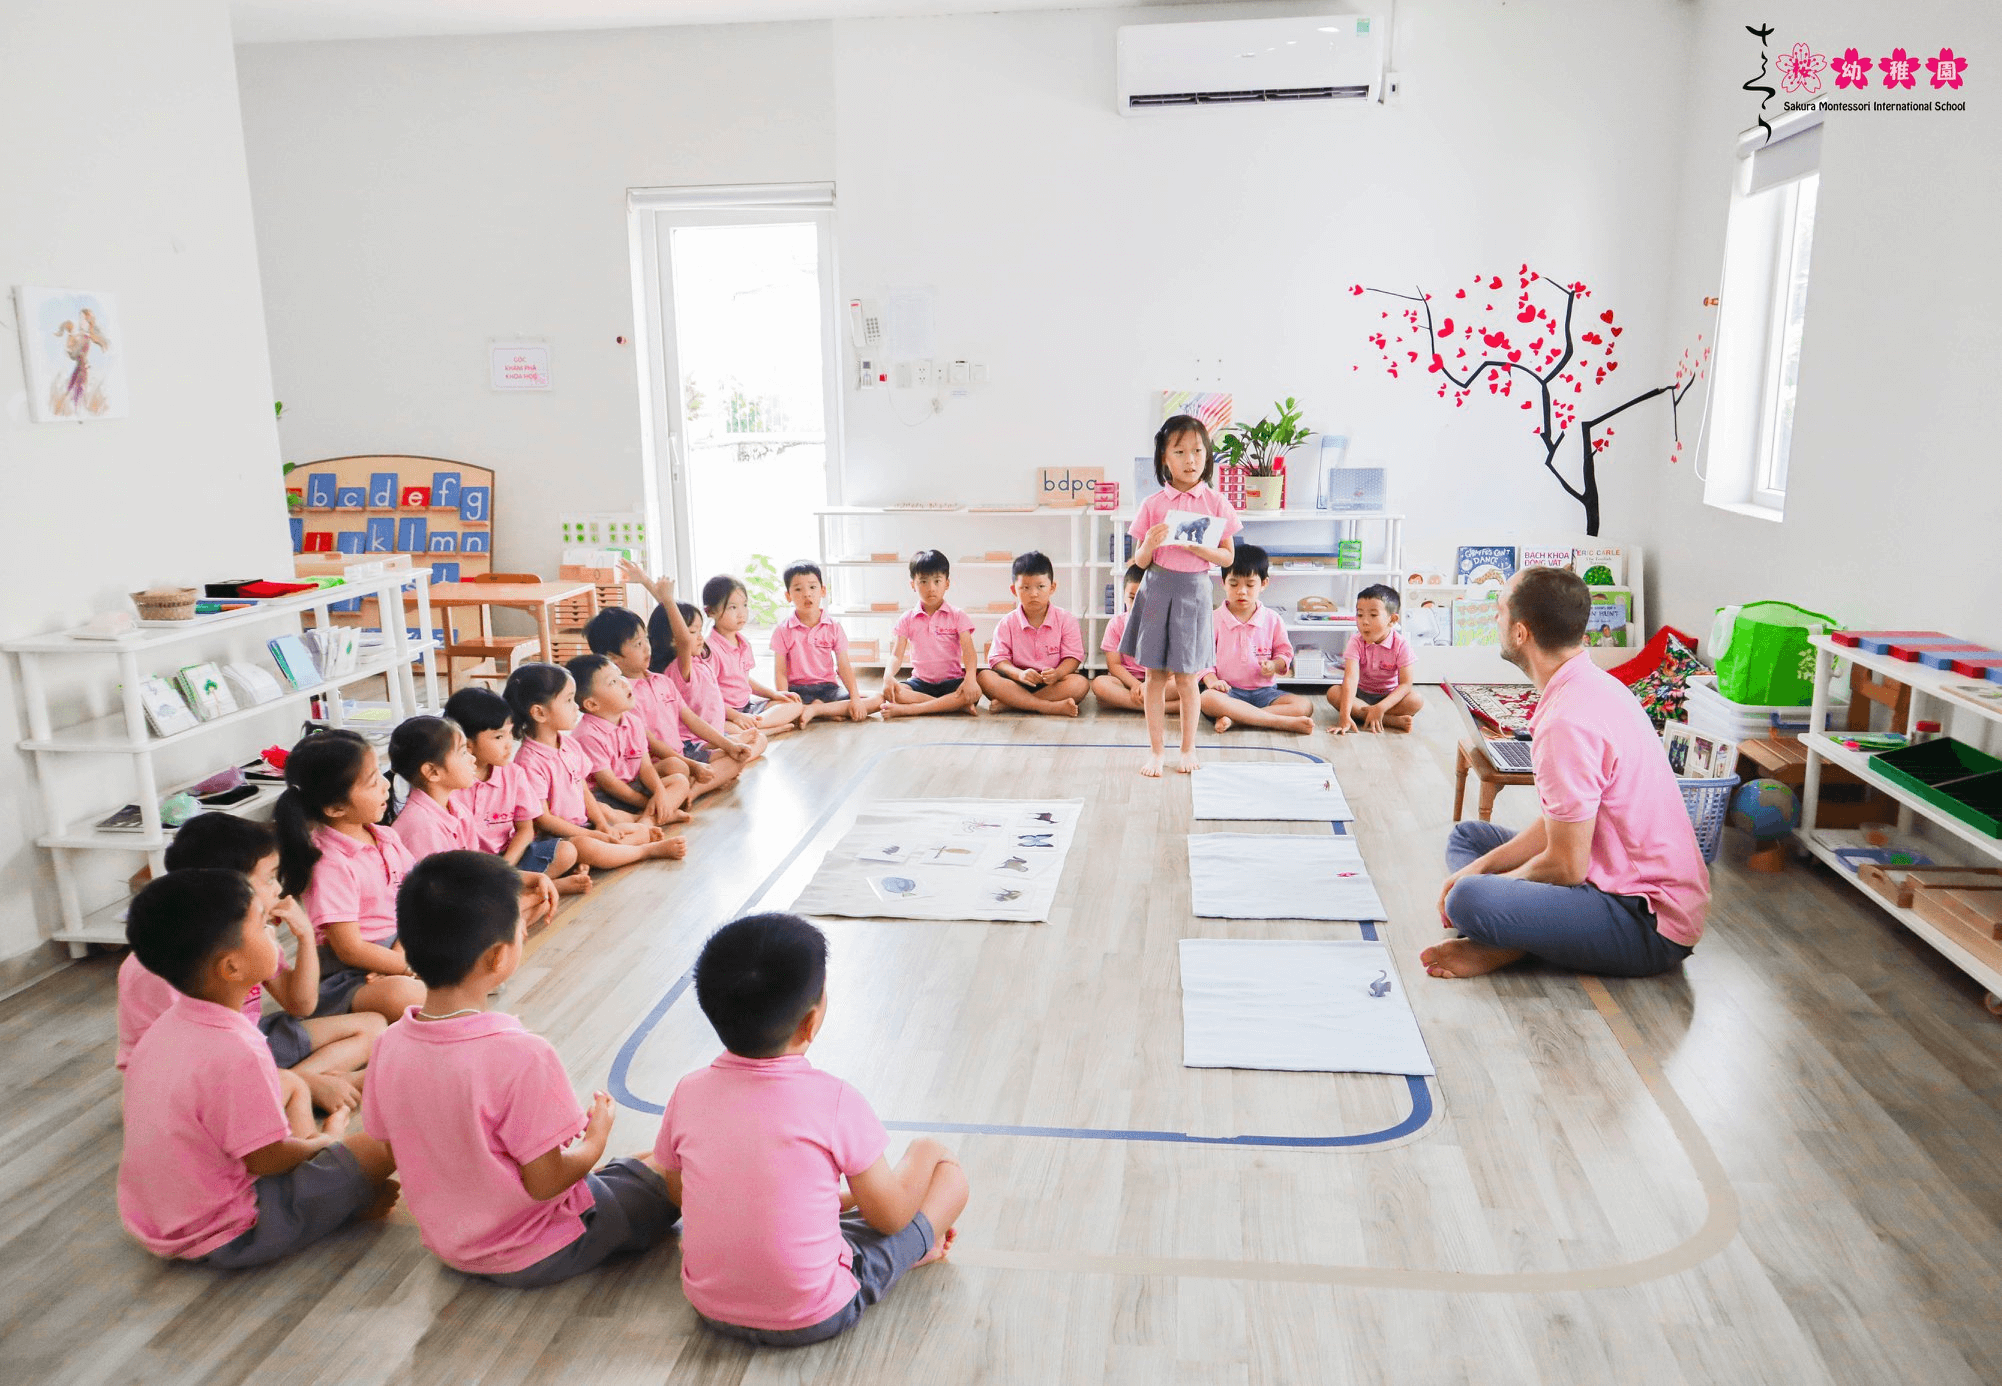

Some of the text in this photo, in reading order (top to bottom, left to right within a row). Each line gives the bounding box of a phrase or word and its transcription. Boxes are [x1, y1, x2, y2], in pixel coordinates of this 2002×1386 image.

[313, 477, 483, 520] b c d e f g
[372, 523, 386, 551] k
[431, 535, 455, 552] m
[466, 536, 482, 552] n
